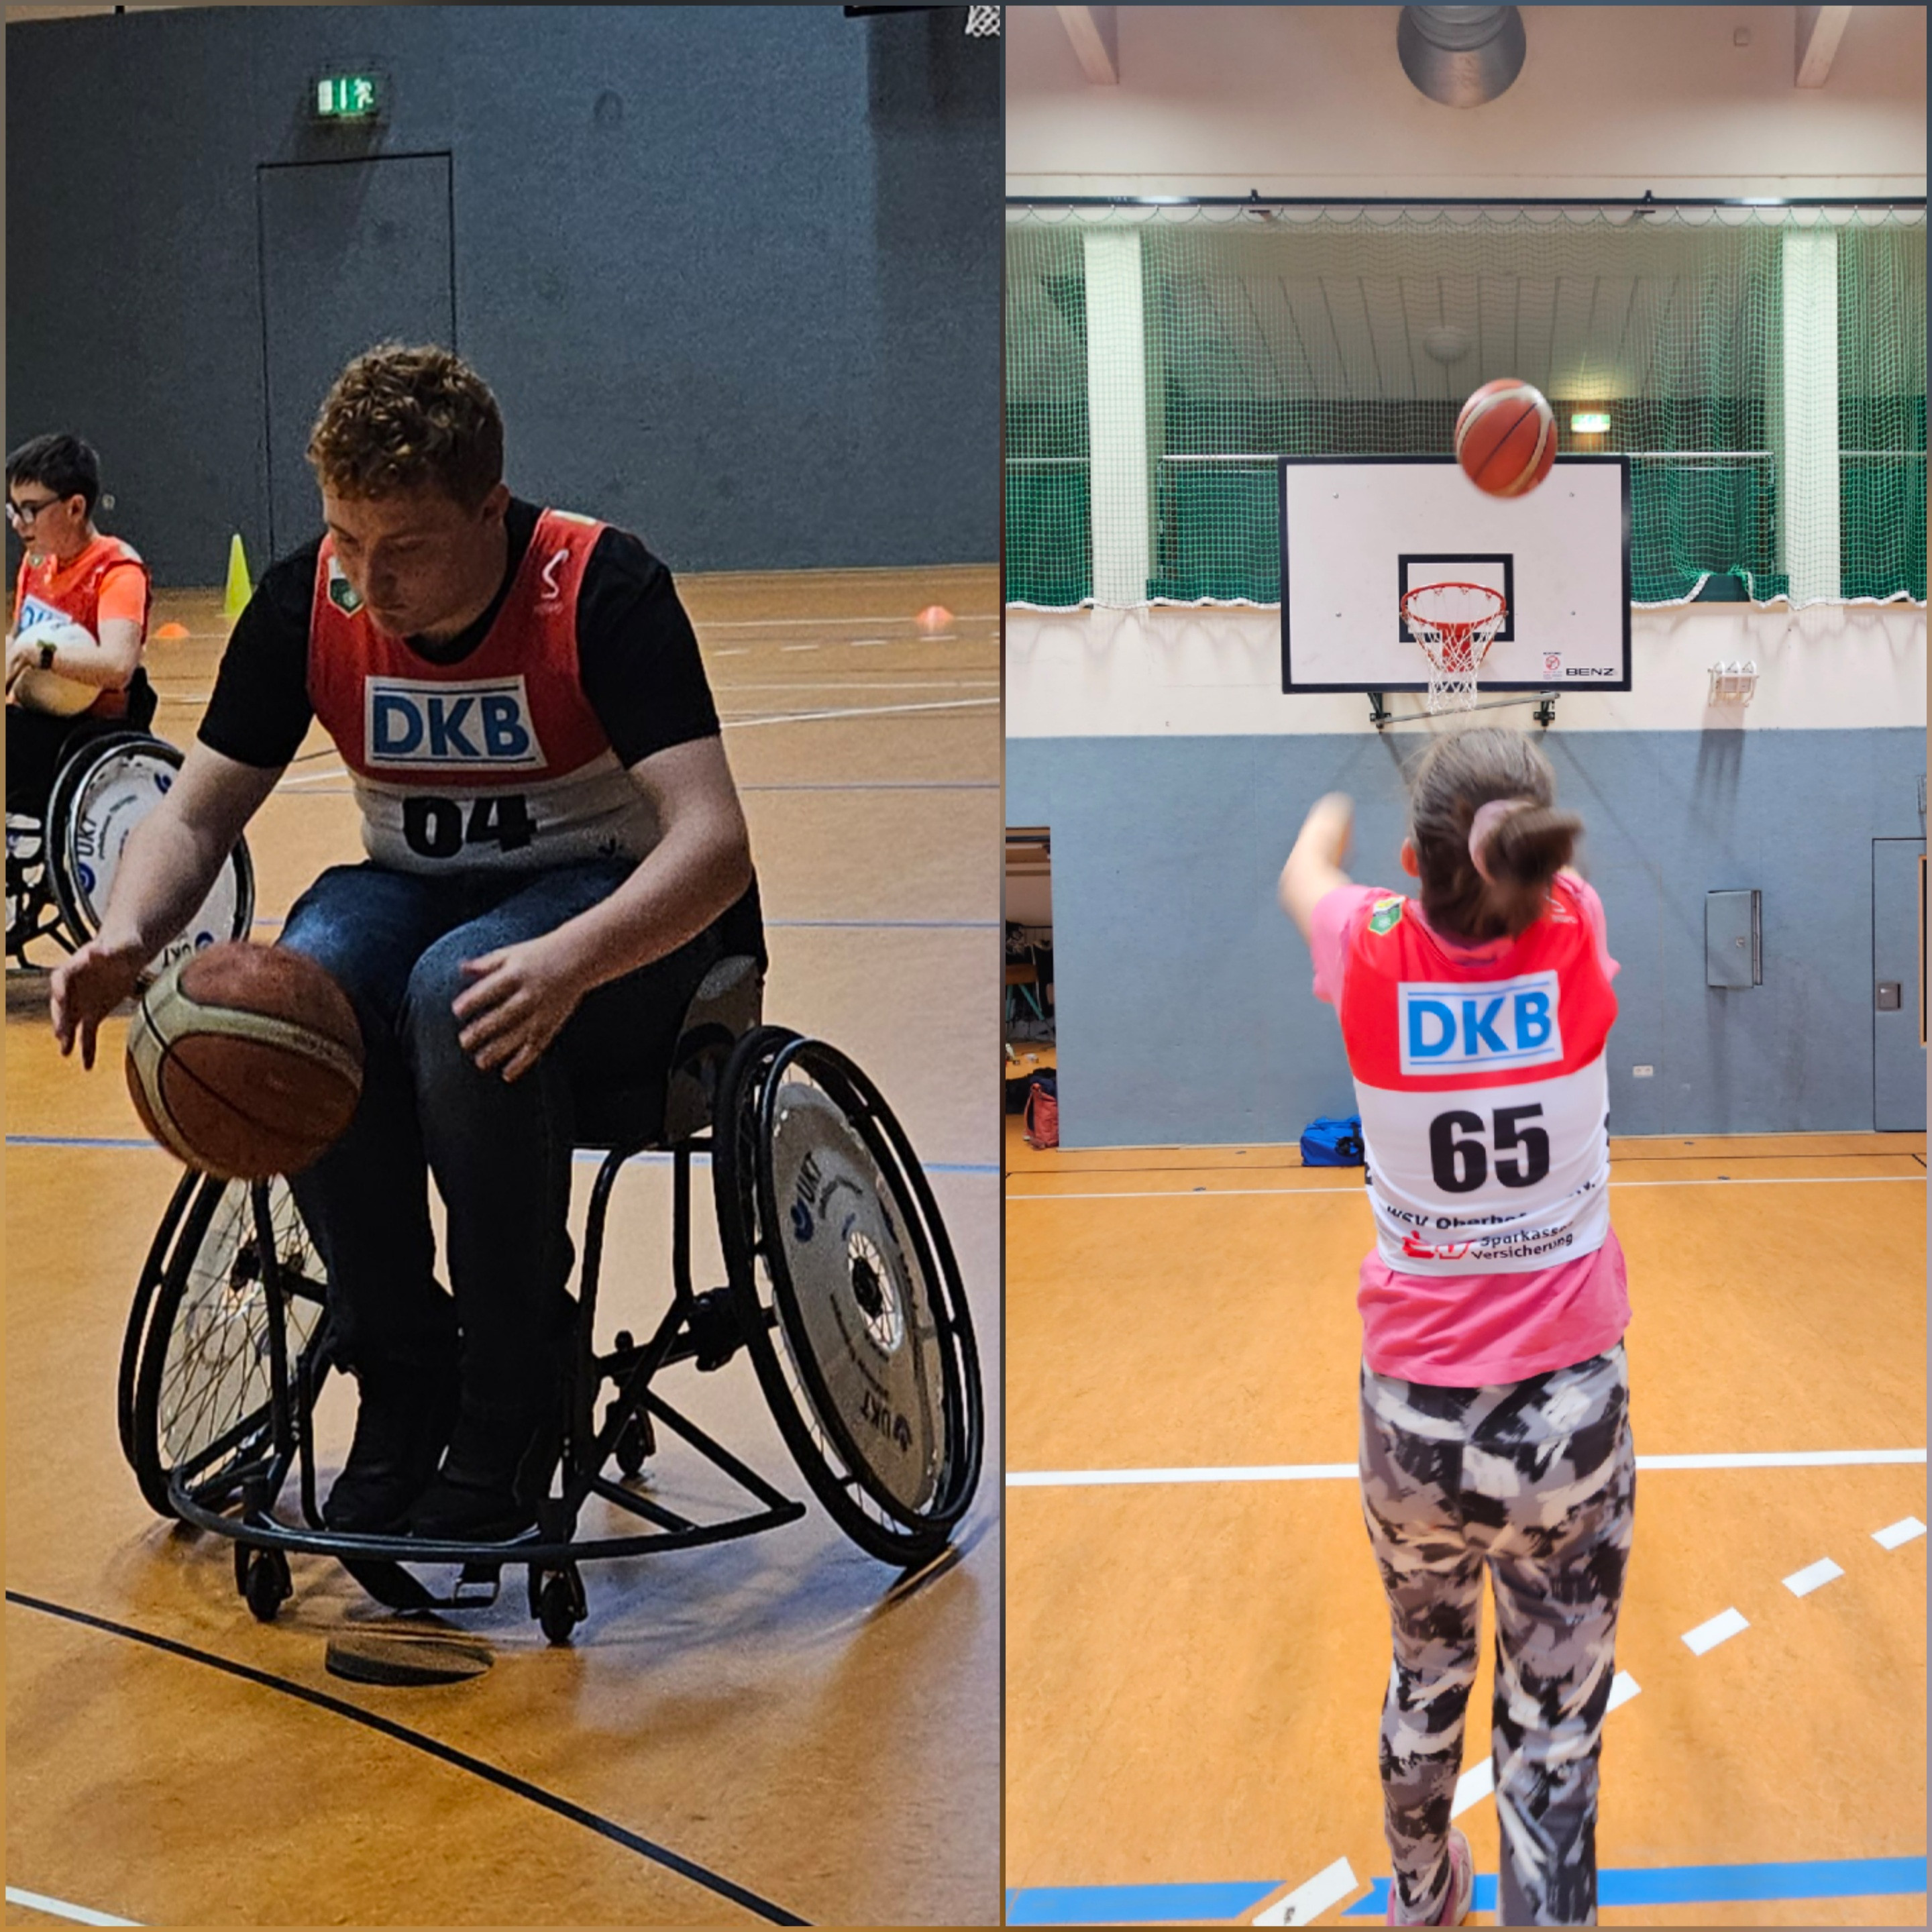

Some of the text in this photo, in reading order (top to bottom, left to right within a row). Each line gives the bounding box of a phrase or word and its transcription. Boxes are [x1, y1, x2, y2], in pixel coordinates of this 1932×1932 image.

[1566, 667, 1614, 676] BENZ
[373, 694, 530, 757] DKB
[1408, 991, 1551, 1057] DKB
[796, 1150, 822, 1204] UKT
[1430, 1103, 1550, 1193] 65
[1470, 1232, 1573, 1260] Versicherung
